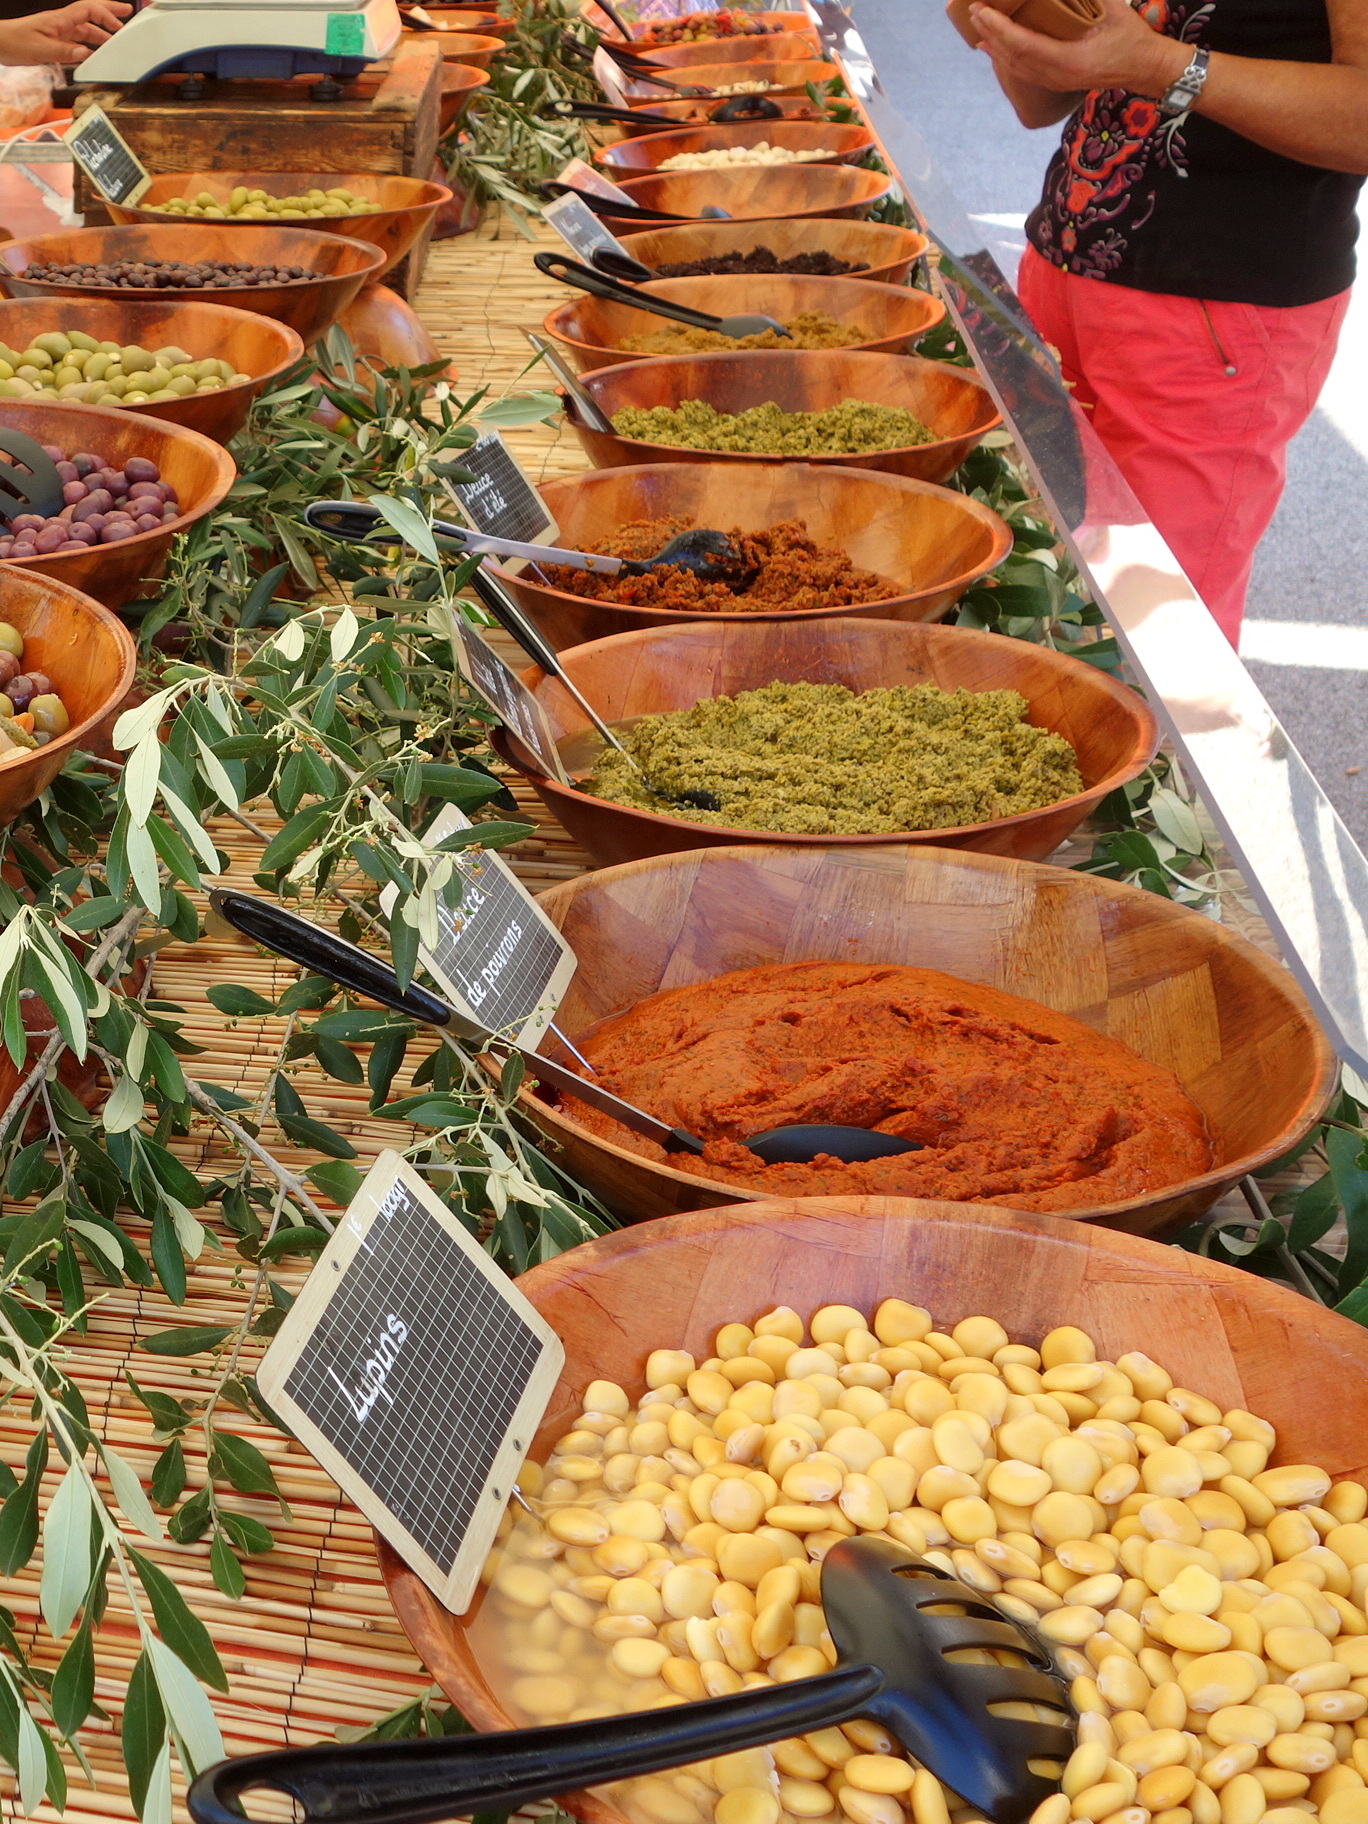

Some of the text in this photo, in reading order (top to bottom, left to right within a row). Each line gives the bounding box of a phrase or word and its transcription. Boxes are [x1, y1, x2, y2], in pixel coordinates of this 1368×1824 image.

[456, 919, 524, 1008] de poivrons
[327, 1312, 410, 1423] Lupins
